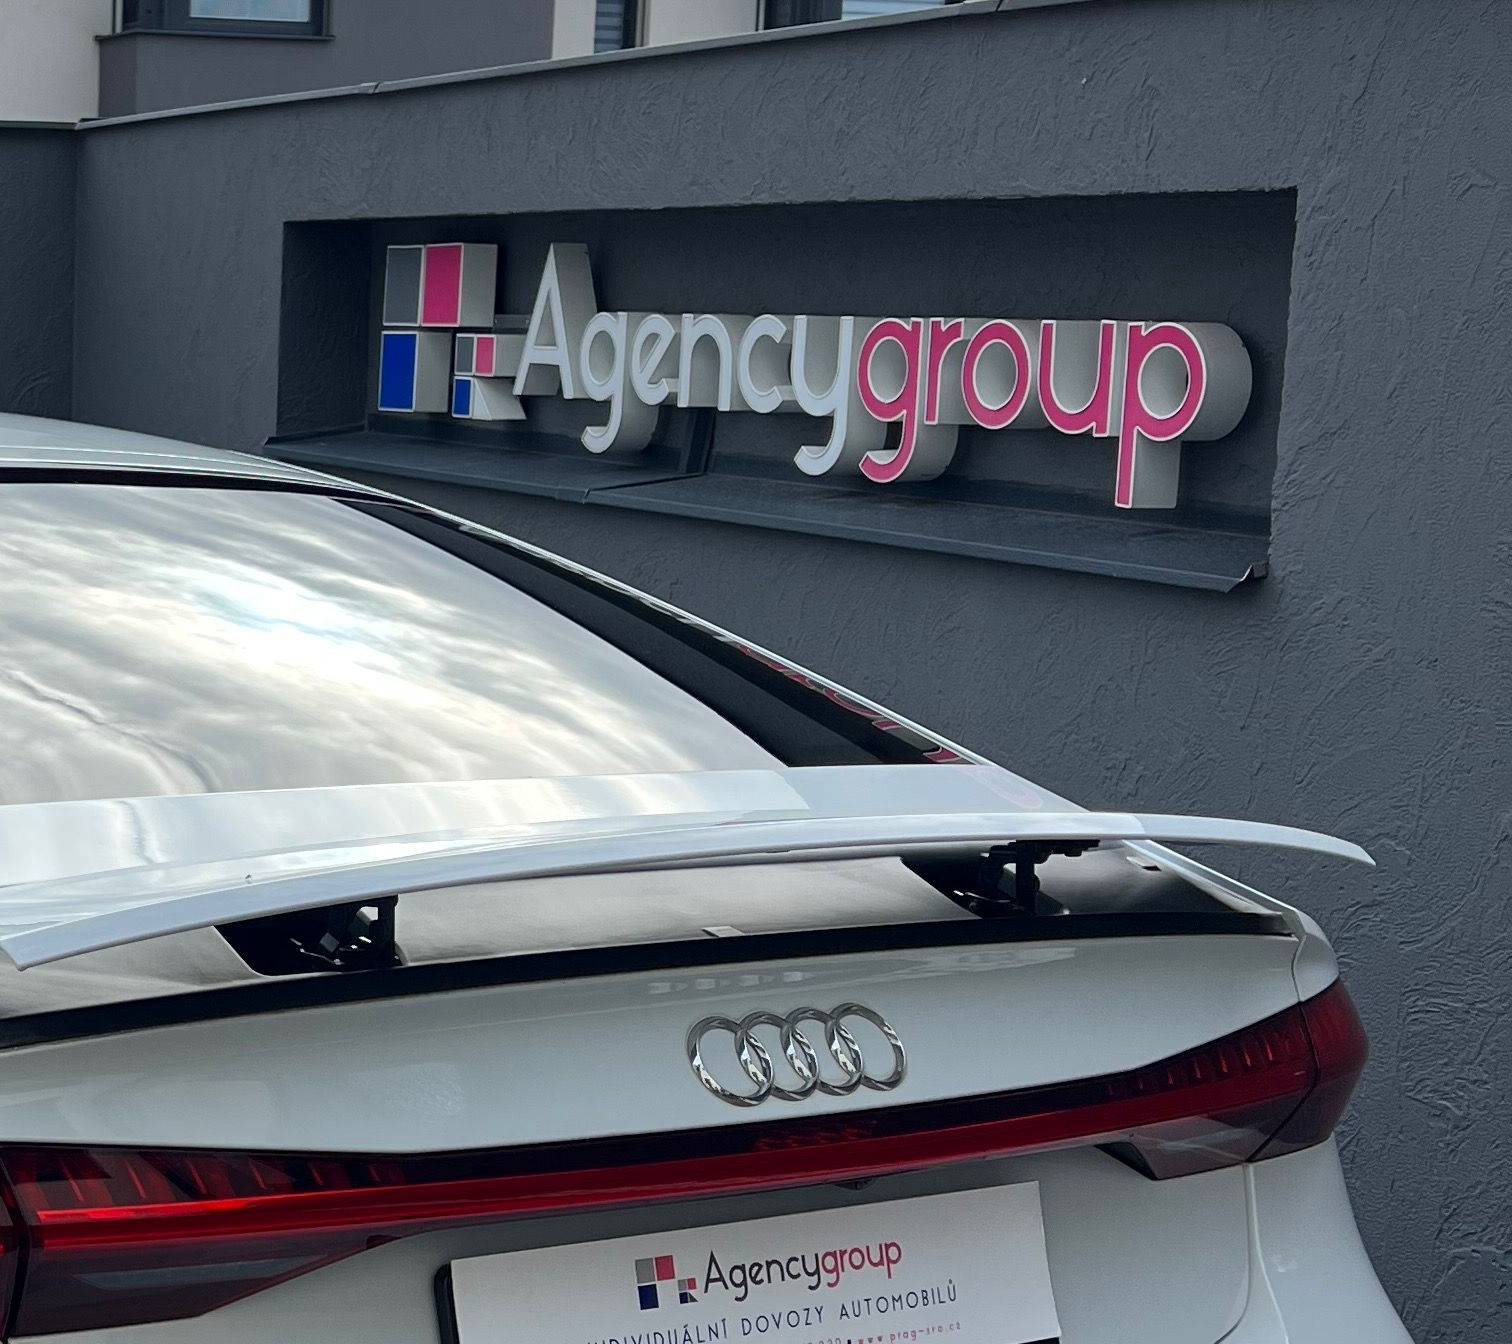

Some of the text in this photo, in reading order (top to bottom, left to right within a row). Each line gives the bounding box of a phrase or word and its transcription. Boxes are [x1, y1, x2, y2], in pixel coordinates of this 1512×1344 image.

[512, 242, 1208, 508] Agencygroup
[703, 1240, 903, 1302] Agencygroup
[741, 1305, 824, 1337] DOVOZY
[839, 1278, 958, 1321] AUTOMOBILŮ
[858, 1321, 961, 1344] wwwprag-srocz
